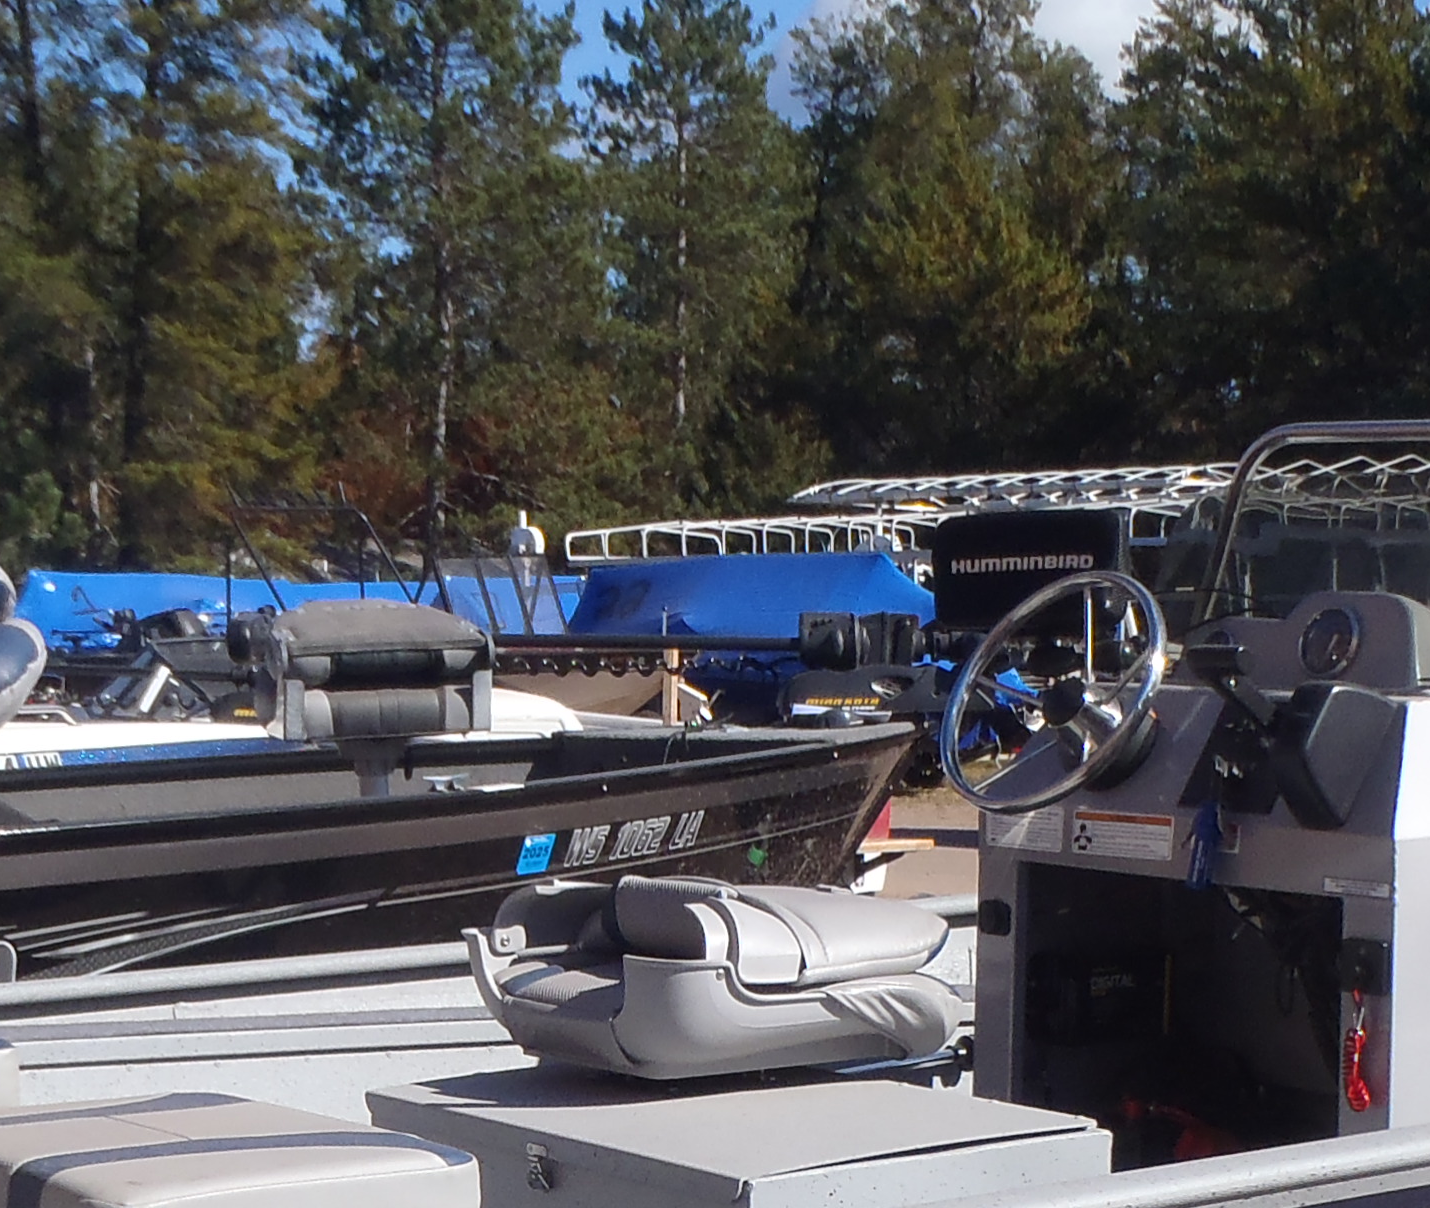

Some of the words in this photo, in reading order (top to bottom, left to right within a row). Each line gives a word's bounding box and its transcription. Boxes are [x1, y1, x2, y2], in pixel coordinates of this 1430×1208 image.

[951, 554, 1094, 575] HUMMINBIRD
[564, 824, 611, 867] WS
[609, 815, 672, 861] 1062
[668, 810, 706, 851] LA
